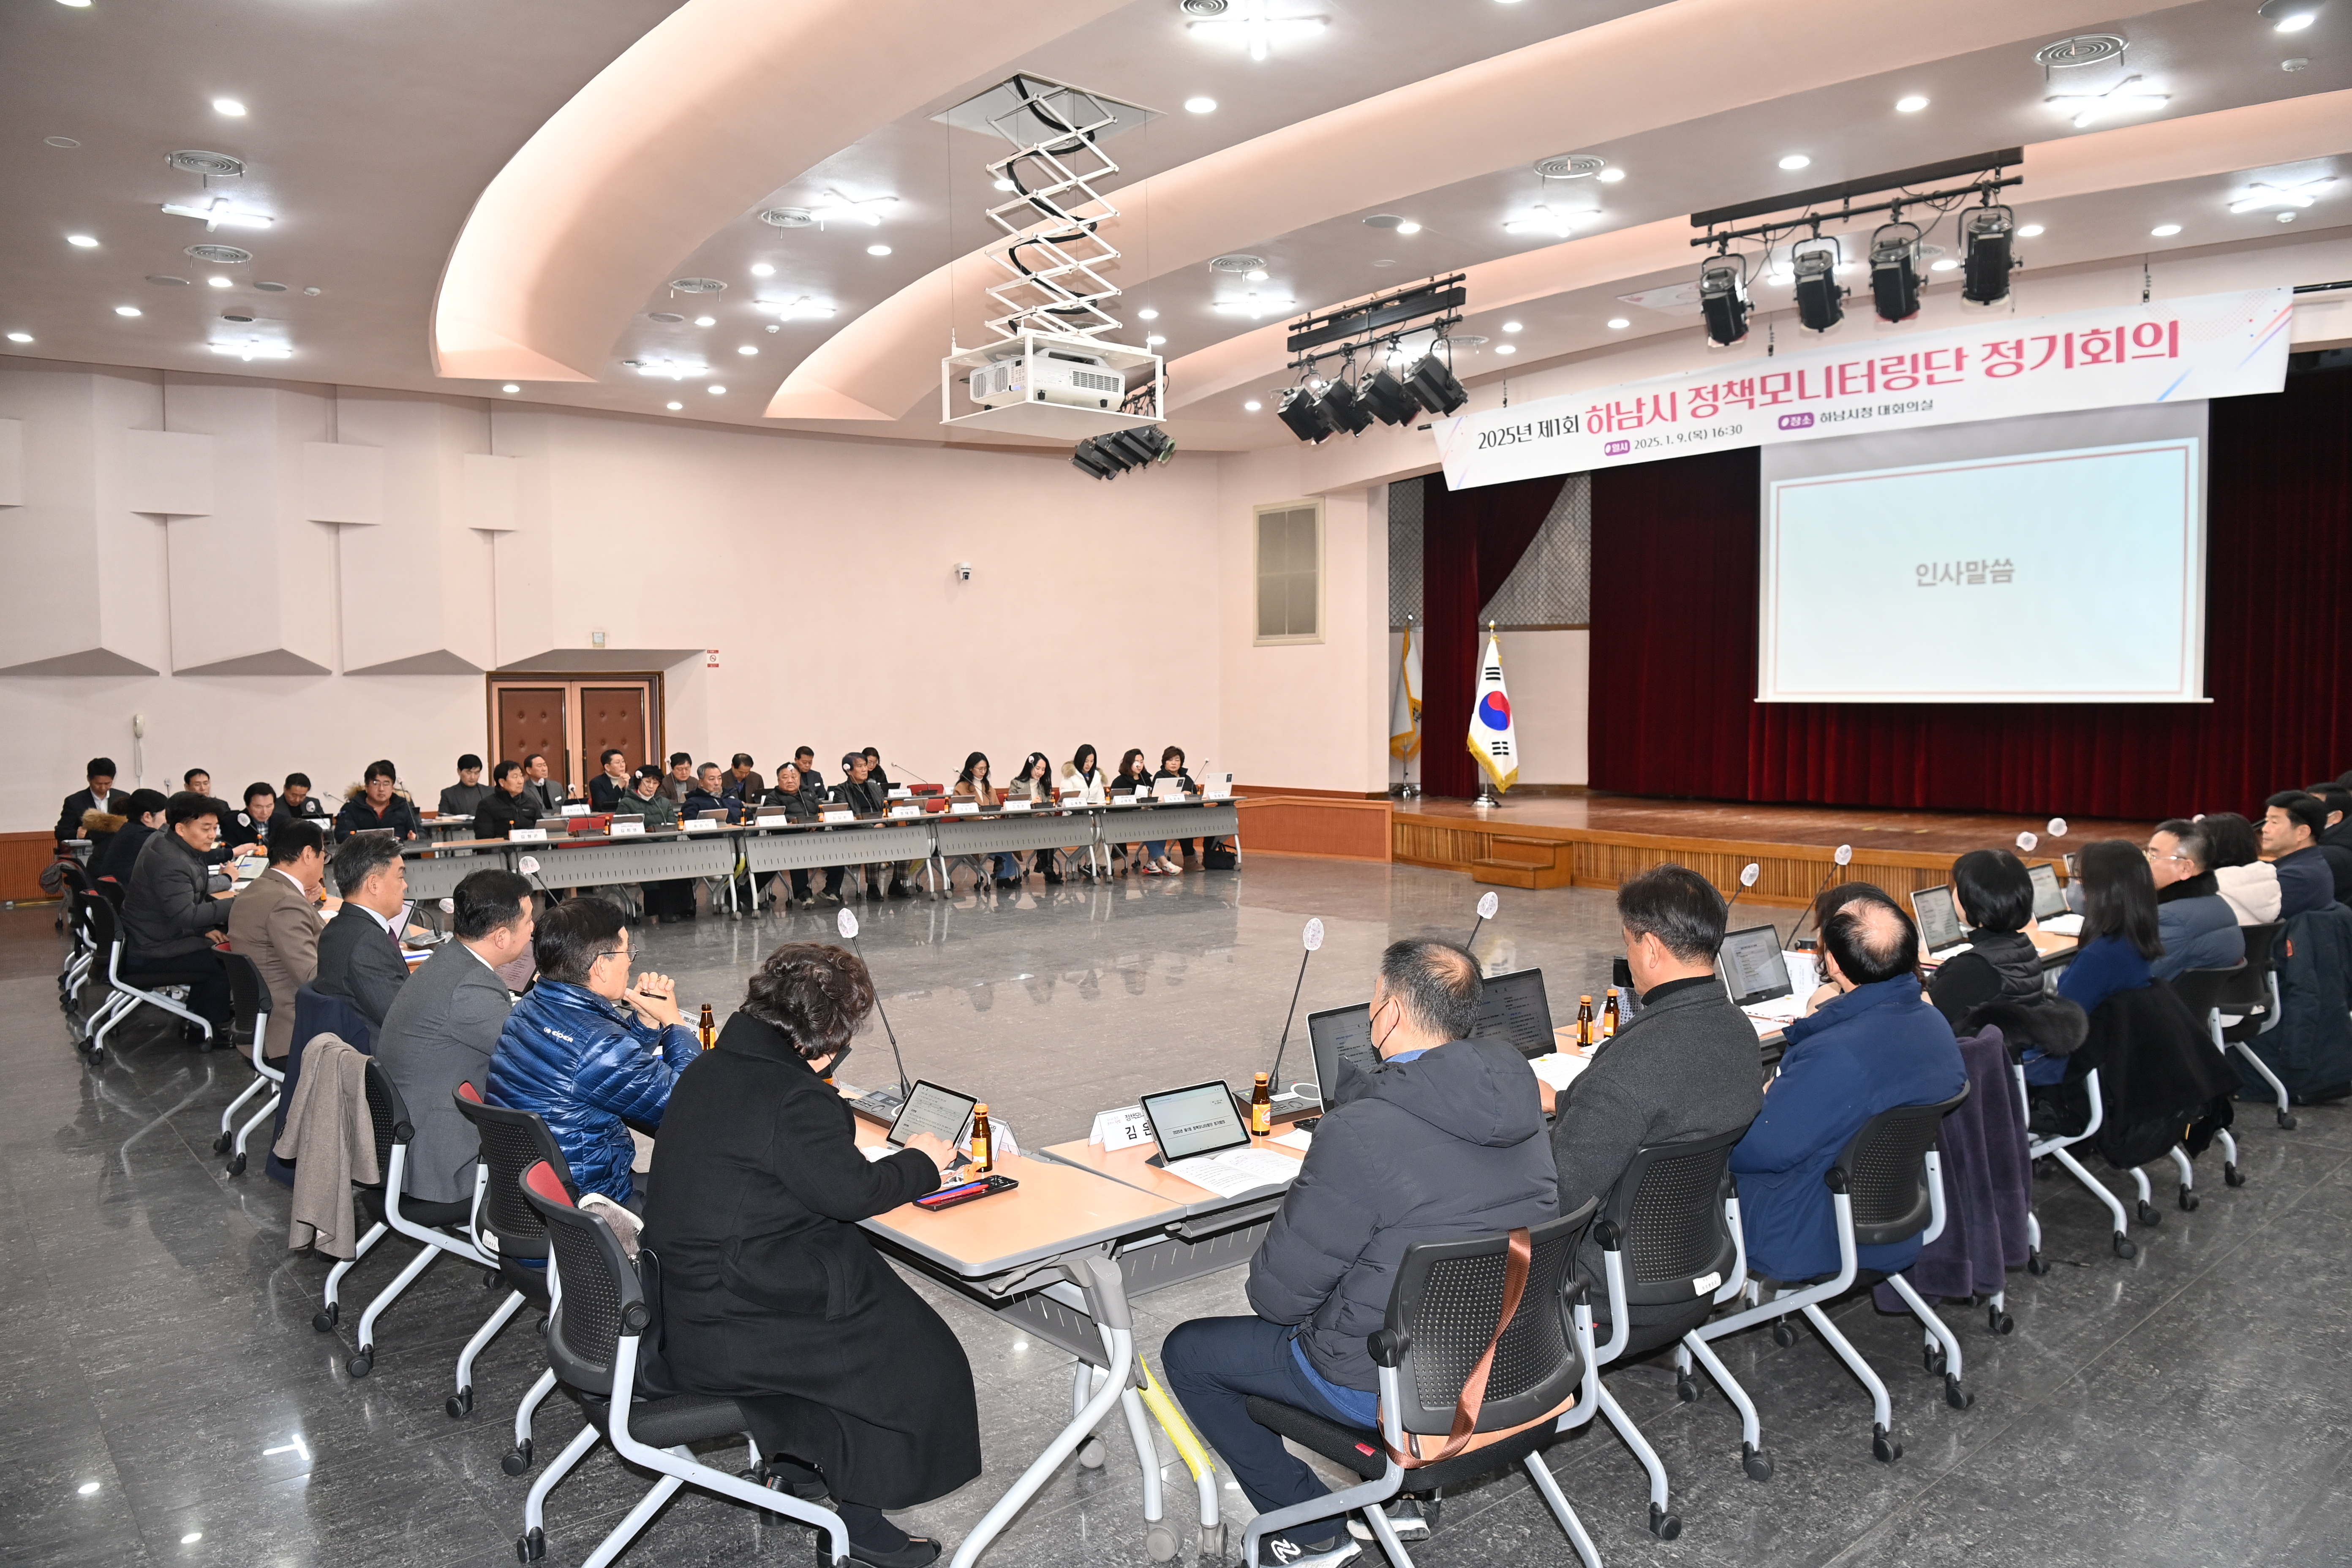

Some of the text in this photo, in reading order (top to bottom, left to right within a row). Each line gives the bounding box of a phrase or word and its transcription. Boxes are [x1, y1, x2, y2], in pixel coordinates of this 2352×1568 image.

[1478, 319, 2180, 449] 2025년 제1회 하남시 정책모니터링단 정기회의
[1790, 416, 1812, 428] 장소
[1819, 399, 1934, 423] 하남시청 대회의실
[1611, 441, 1629, 453] 일시
[1634, 437, 1663, 450] 2025.
[1712, 424, 1742, 438] 16:30
[1916, 558, 2015, 587] 인사말씀
